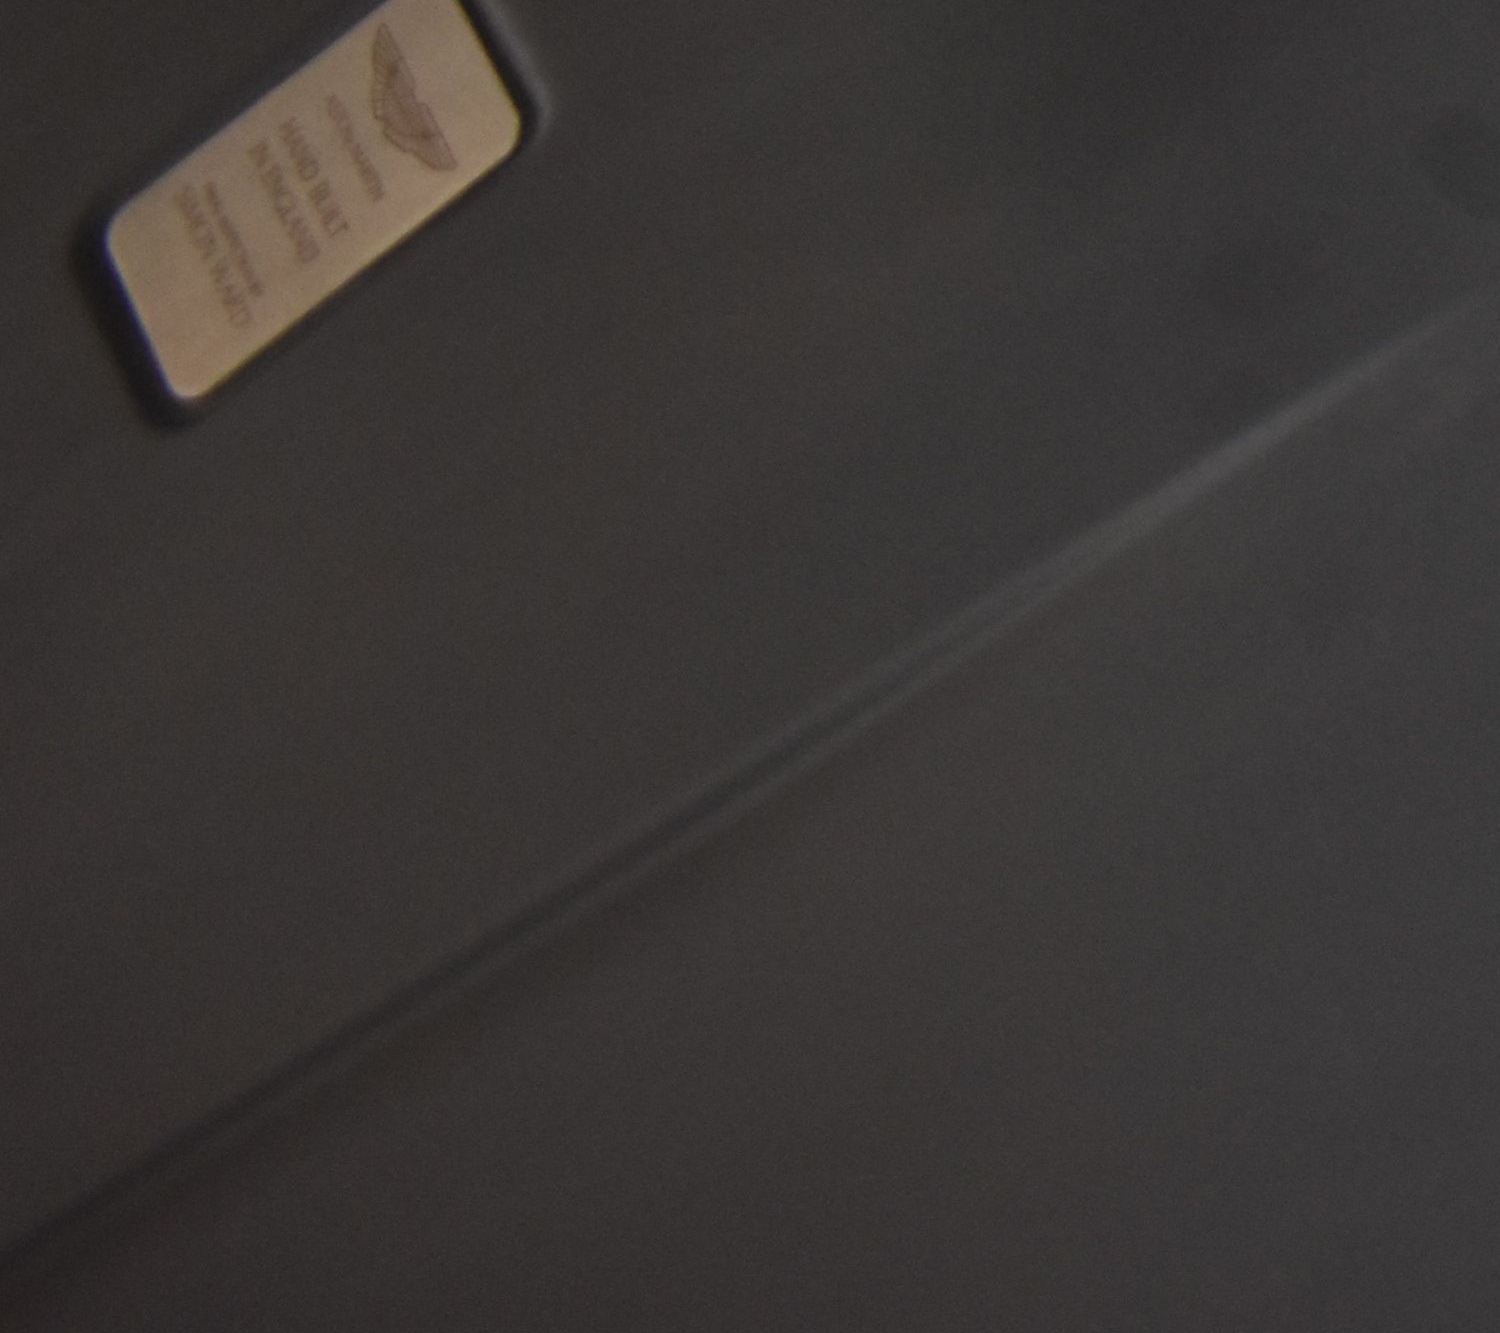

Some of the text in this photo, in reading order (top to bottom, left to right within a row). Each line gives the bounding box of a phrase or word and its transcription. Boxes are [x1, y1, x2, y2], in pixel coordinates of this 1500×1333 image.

[259, 163, 322, 266] ENGLAND
[275, 116, 348, 240] HAND BUILT
